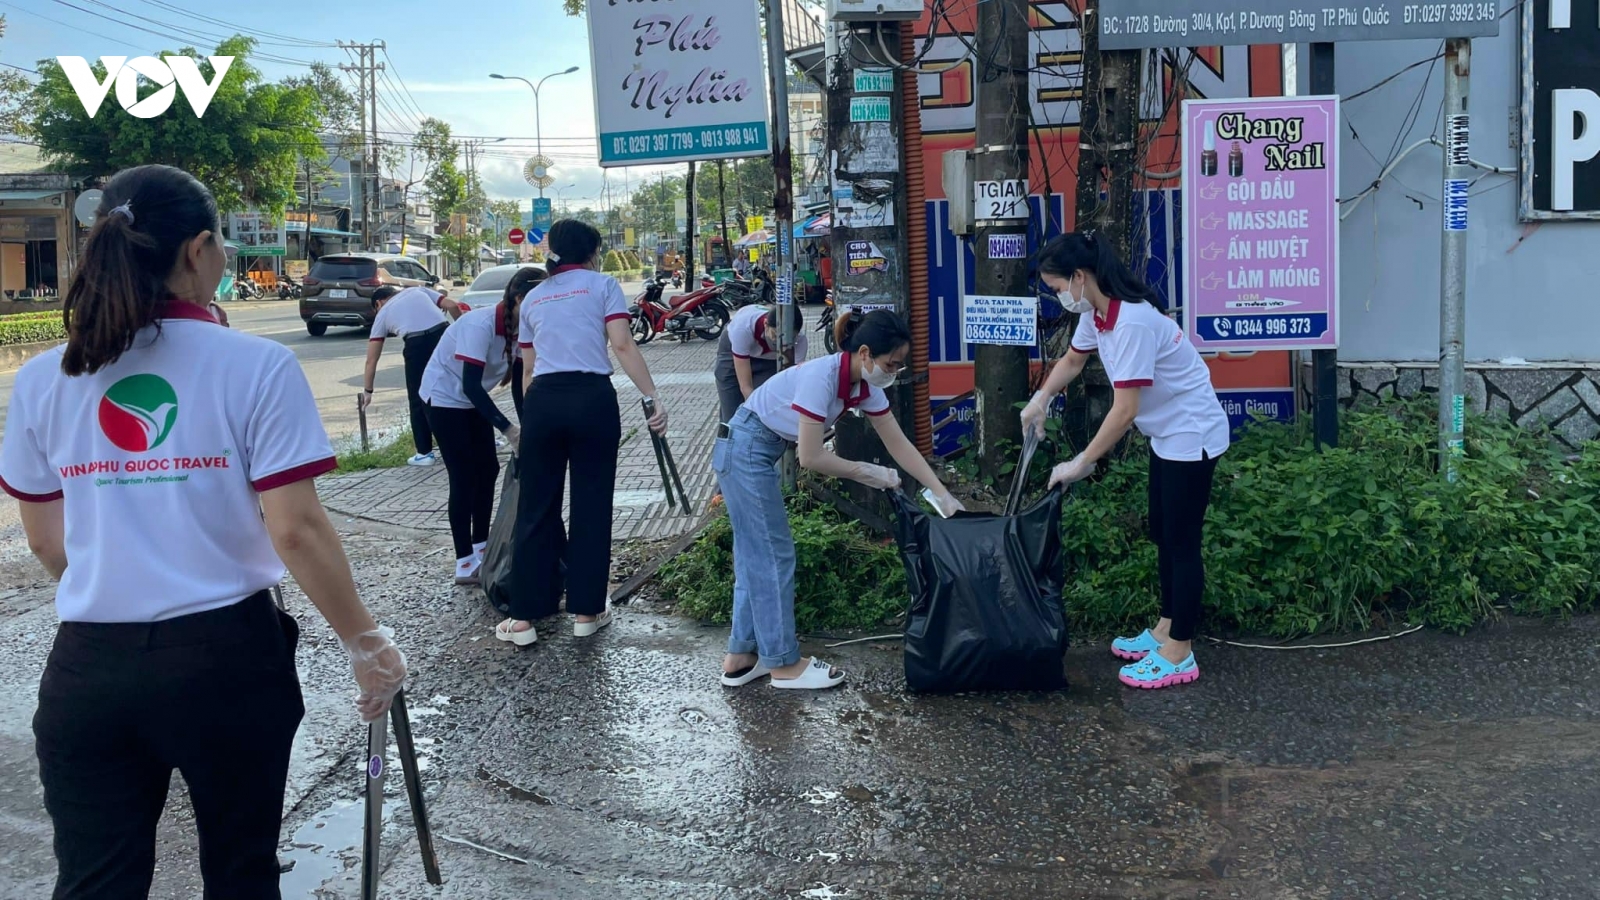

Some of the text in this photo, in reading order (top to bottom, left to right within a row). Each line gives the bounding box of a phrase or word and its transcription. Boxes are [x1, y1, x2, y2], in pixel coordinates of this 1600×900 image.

[1103, 16, 1123, 35] ĐC:
[1125, 15, 1150, 34] 172/8
[1153, 14, 1188, 37] Đường
[1191, 12, 1214, 34] 30/4,
[1216, 12, 1236, 34] Kp1,
[1239, 11, 1248, 30] P.
[1249, 10, 1285, 33] Dương
[1288, 9, 1316, 32] Đông
[1321, 8, 1336, 27] TP.
[1338, 6, 1358, 26] Phú
[1362, 2, 1390, 26] Quốc
[1449, 3, 1474, 22] 3992
[1476, 2, 1496, 21] 345
[629, 135, 651, 154] 0297
[652, 133, 669, 152] 397
[670, 131, 694, 150] 7799
[701, 129, 724, 149] 0913
[724, 128, 742, 147] 988
[743, 126, 760, 145] 941
[1216, 112, 1304, 144] Chang
[1263, 142, 1326, 171] Nail
[1227, 174, 1295, 205] GỘI ĐẦU
[1227, 209, 1309, 231] MASSAGE
[1227, 234, 1309, 262] ẤN HUYỆT
[1227, 264, 1320, 289] LÀM MÓNG
[966, 325, 1034, 341] 0866.652.379
[1234, 317, 1312, 336] 0344 996 373
[124, 458, 170, 473] QUOC
[173, 456, 230, 470] TRAVEL
